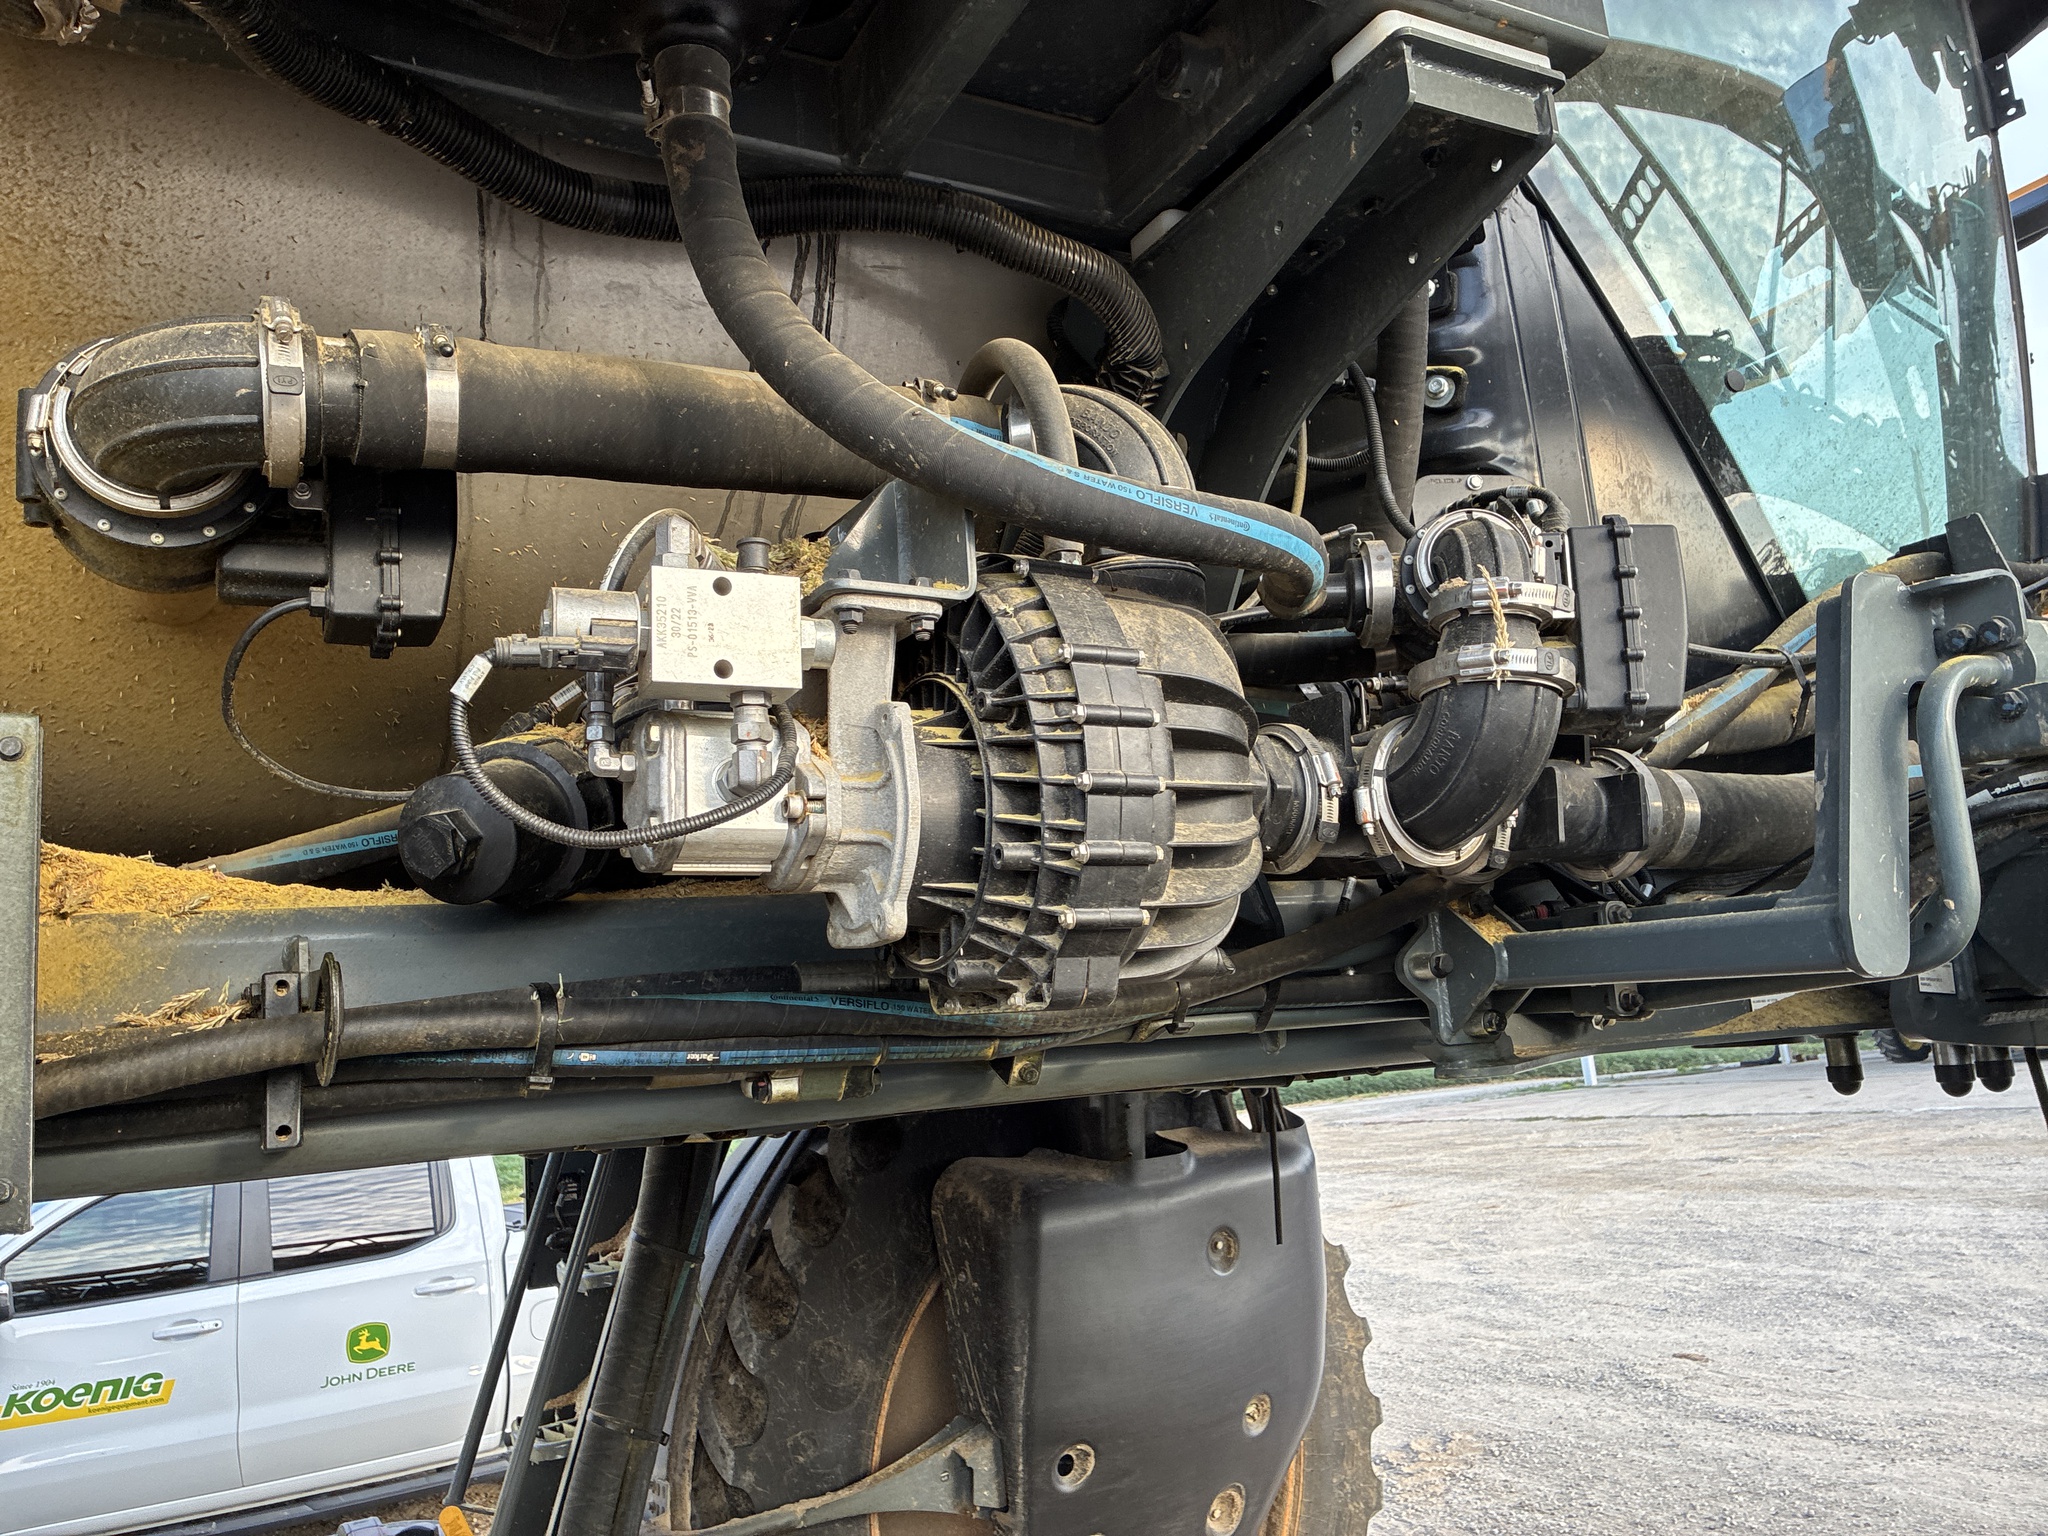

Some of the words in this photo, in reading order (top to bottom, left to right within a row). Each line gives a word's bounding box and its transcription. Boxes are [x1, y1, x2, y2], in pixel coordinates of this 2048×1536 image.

[1082, 474, 1116, 490] WATER
[1117, 484, 1133, 495] 150
[1136, 489, 1199, 518] VERSIFLO
[1212, 513, 1251, 532] Continental
[655, 596, 668, 650] AKK35210
[670, 607, 682, 639] 30/22
[322, 843, 348, 853] WATER
[347, 841, 359, 849] 150
[361, 833, 399, 848] RSIFLO
[769, 993, 814, 1003] Continental
[830, 997, 890, 1011] VERSIFLO
[686, 1051, 719, 1064] Parker
[320, 1372, 363, 1389] JOHN
[366, 1362, 416, 1380] DEERE
[11, 1383, 33, 1392] Since
[36, 1379, 56, 1390] 1904
